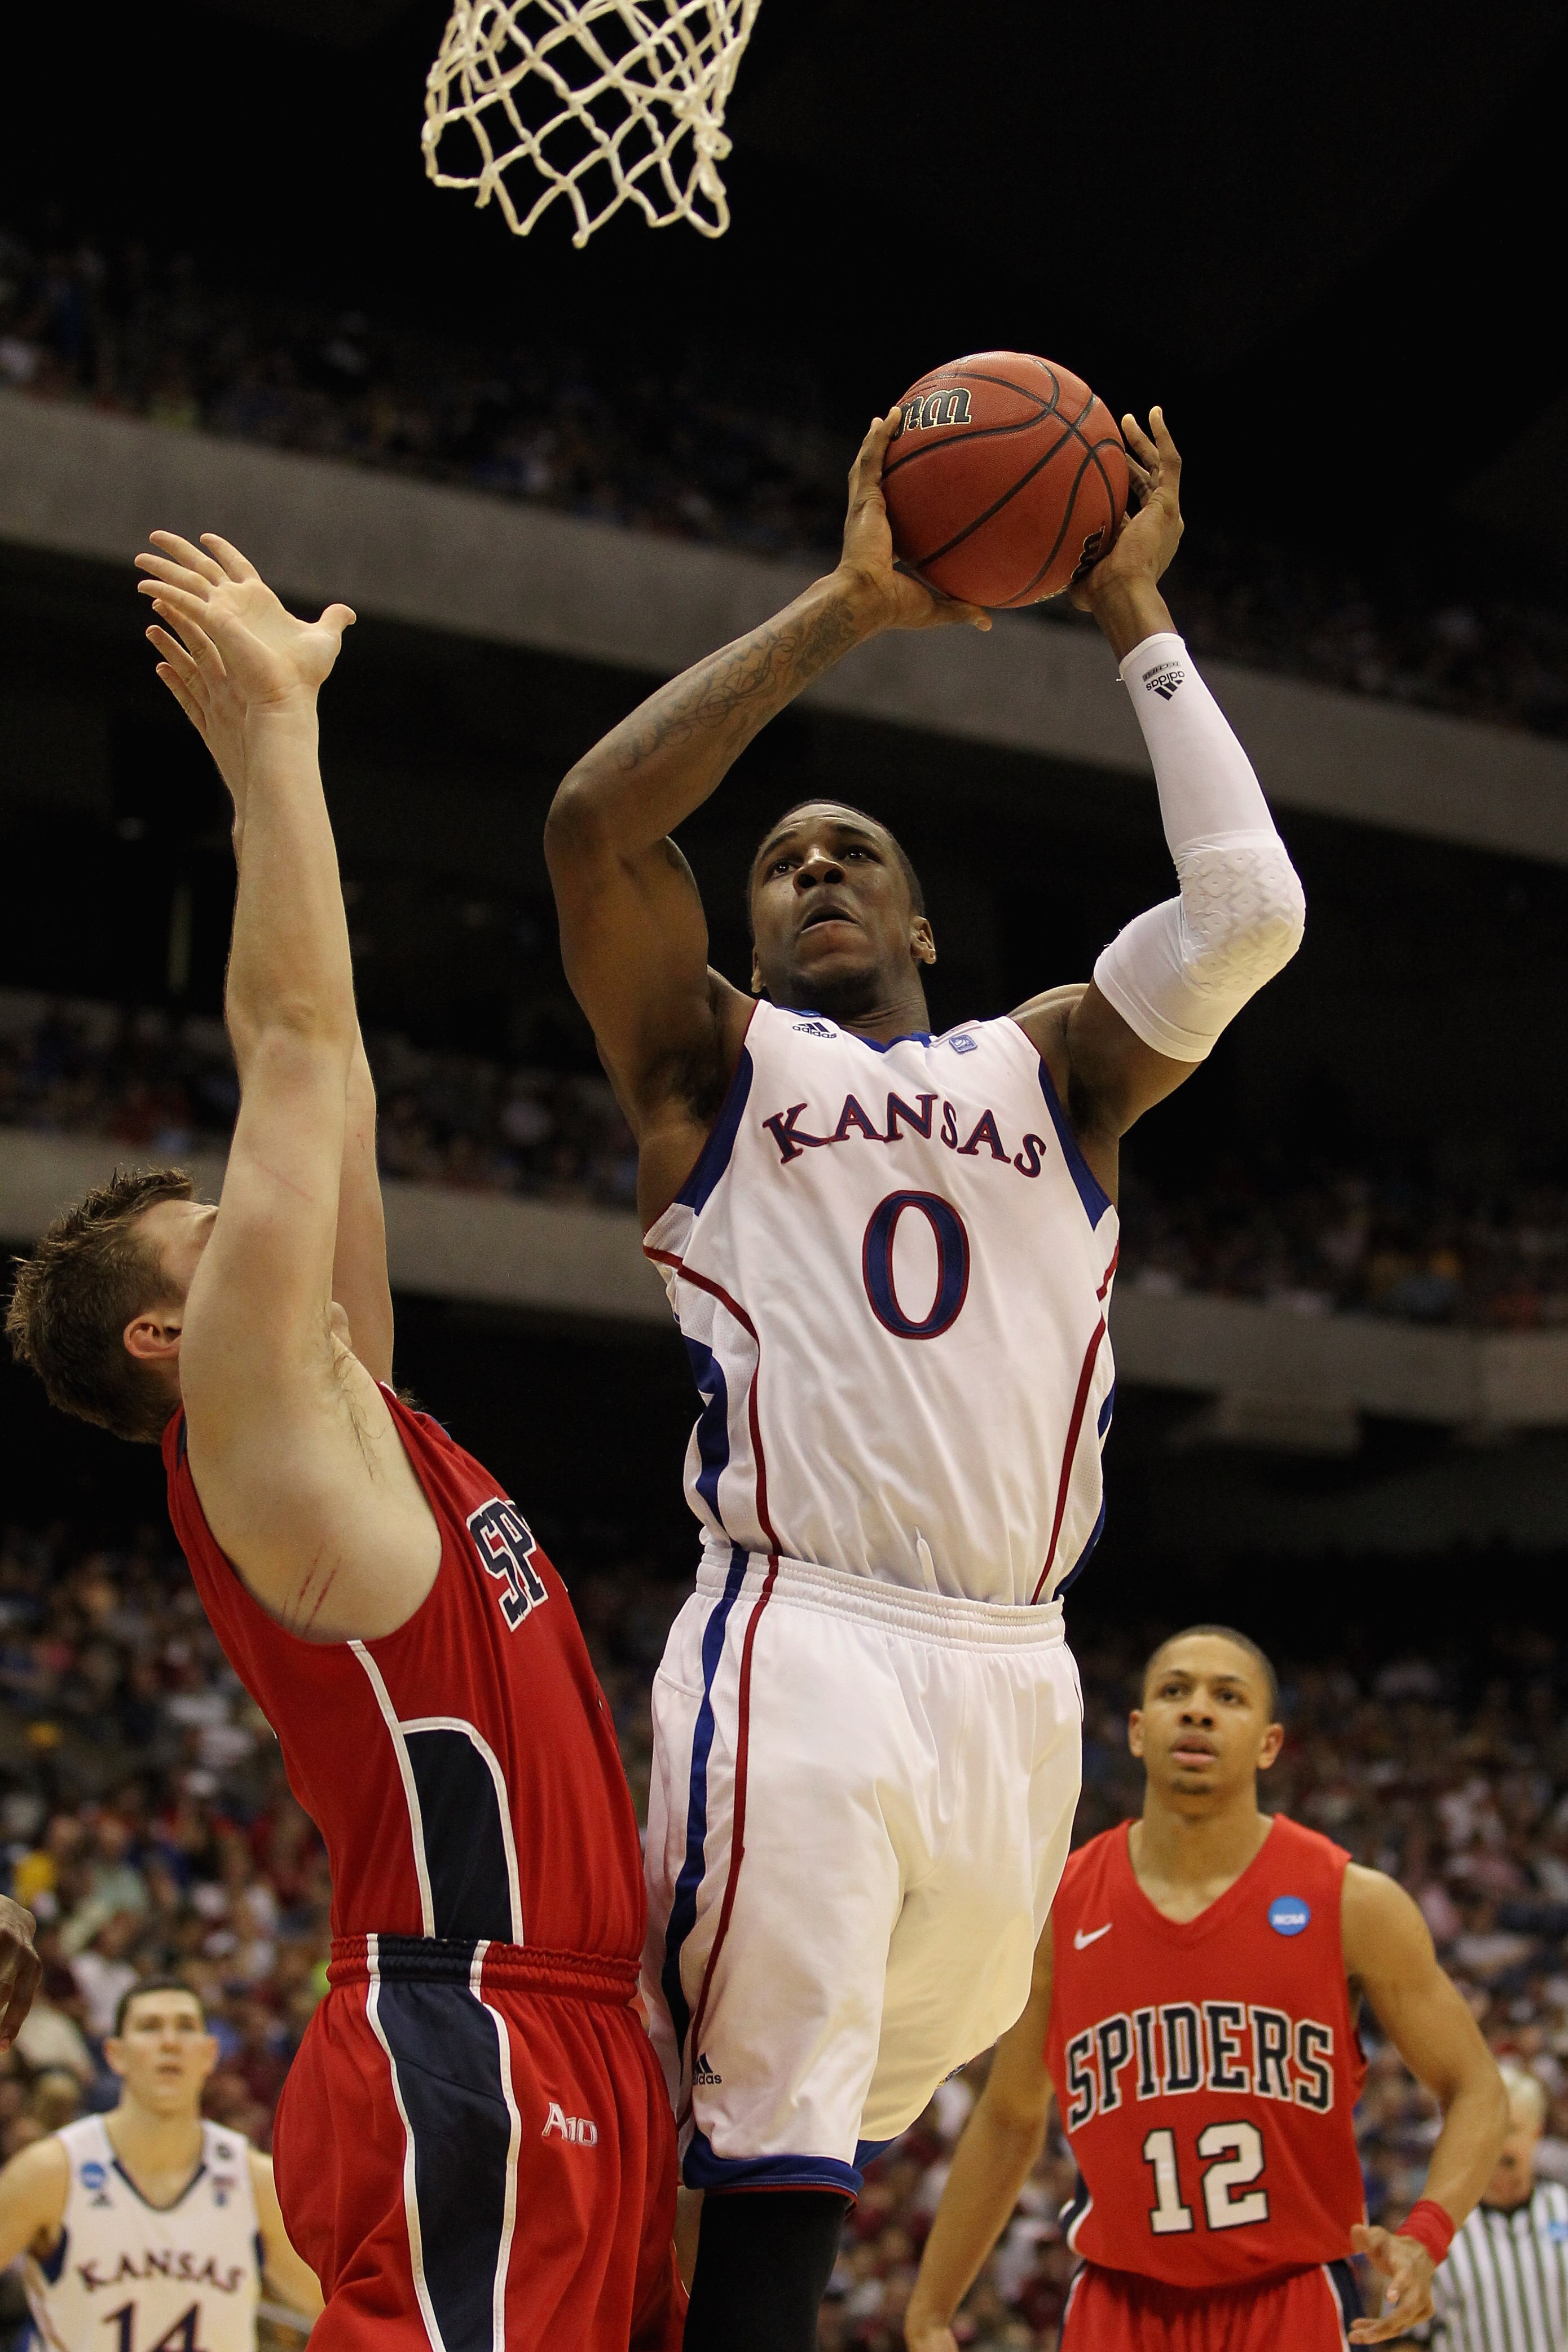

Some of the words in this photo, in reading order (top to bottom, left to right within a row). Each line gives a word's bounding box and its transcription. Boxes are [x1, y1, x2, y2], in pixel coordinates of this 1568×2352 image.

[892, 387, 972, 438] Wil
[1146, 671, 1185, 691] adidas
[792, 1025, 837, 1038] adidas
[763, 1092, 1046, 1178] KANSAS
[862, 1190, 970, 1340] 0
[1066, 2001, 1333, 2133] SPIDERS
[541, 2102, 598, 2147] A10
[1143, 2120, 1269, 2236] 12
[76, 2248, 245, 2293] KANSAS
[101, 2298, 206, 2352] 14
